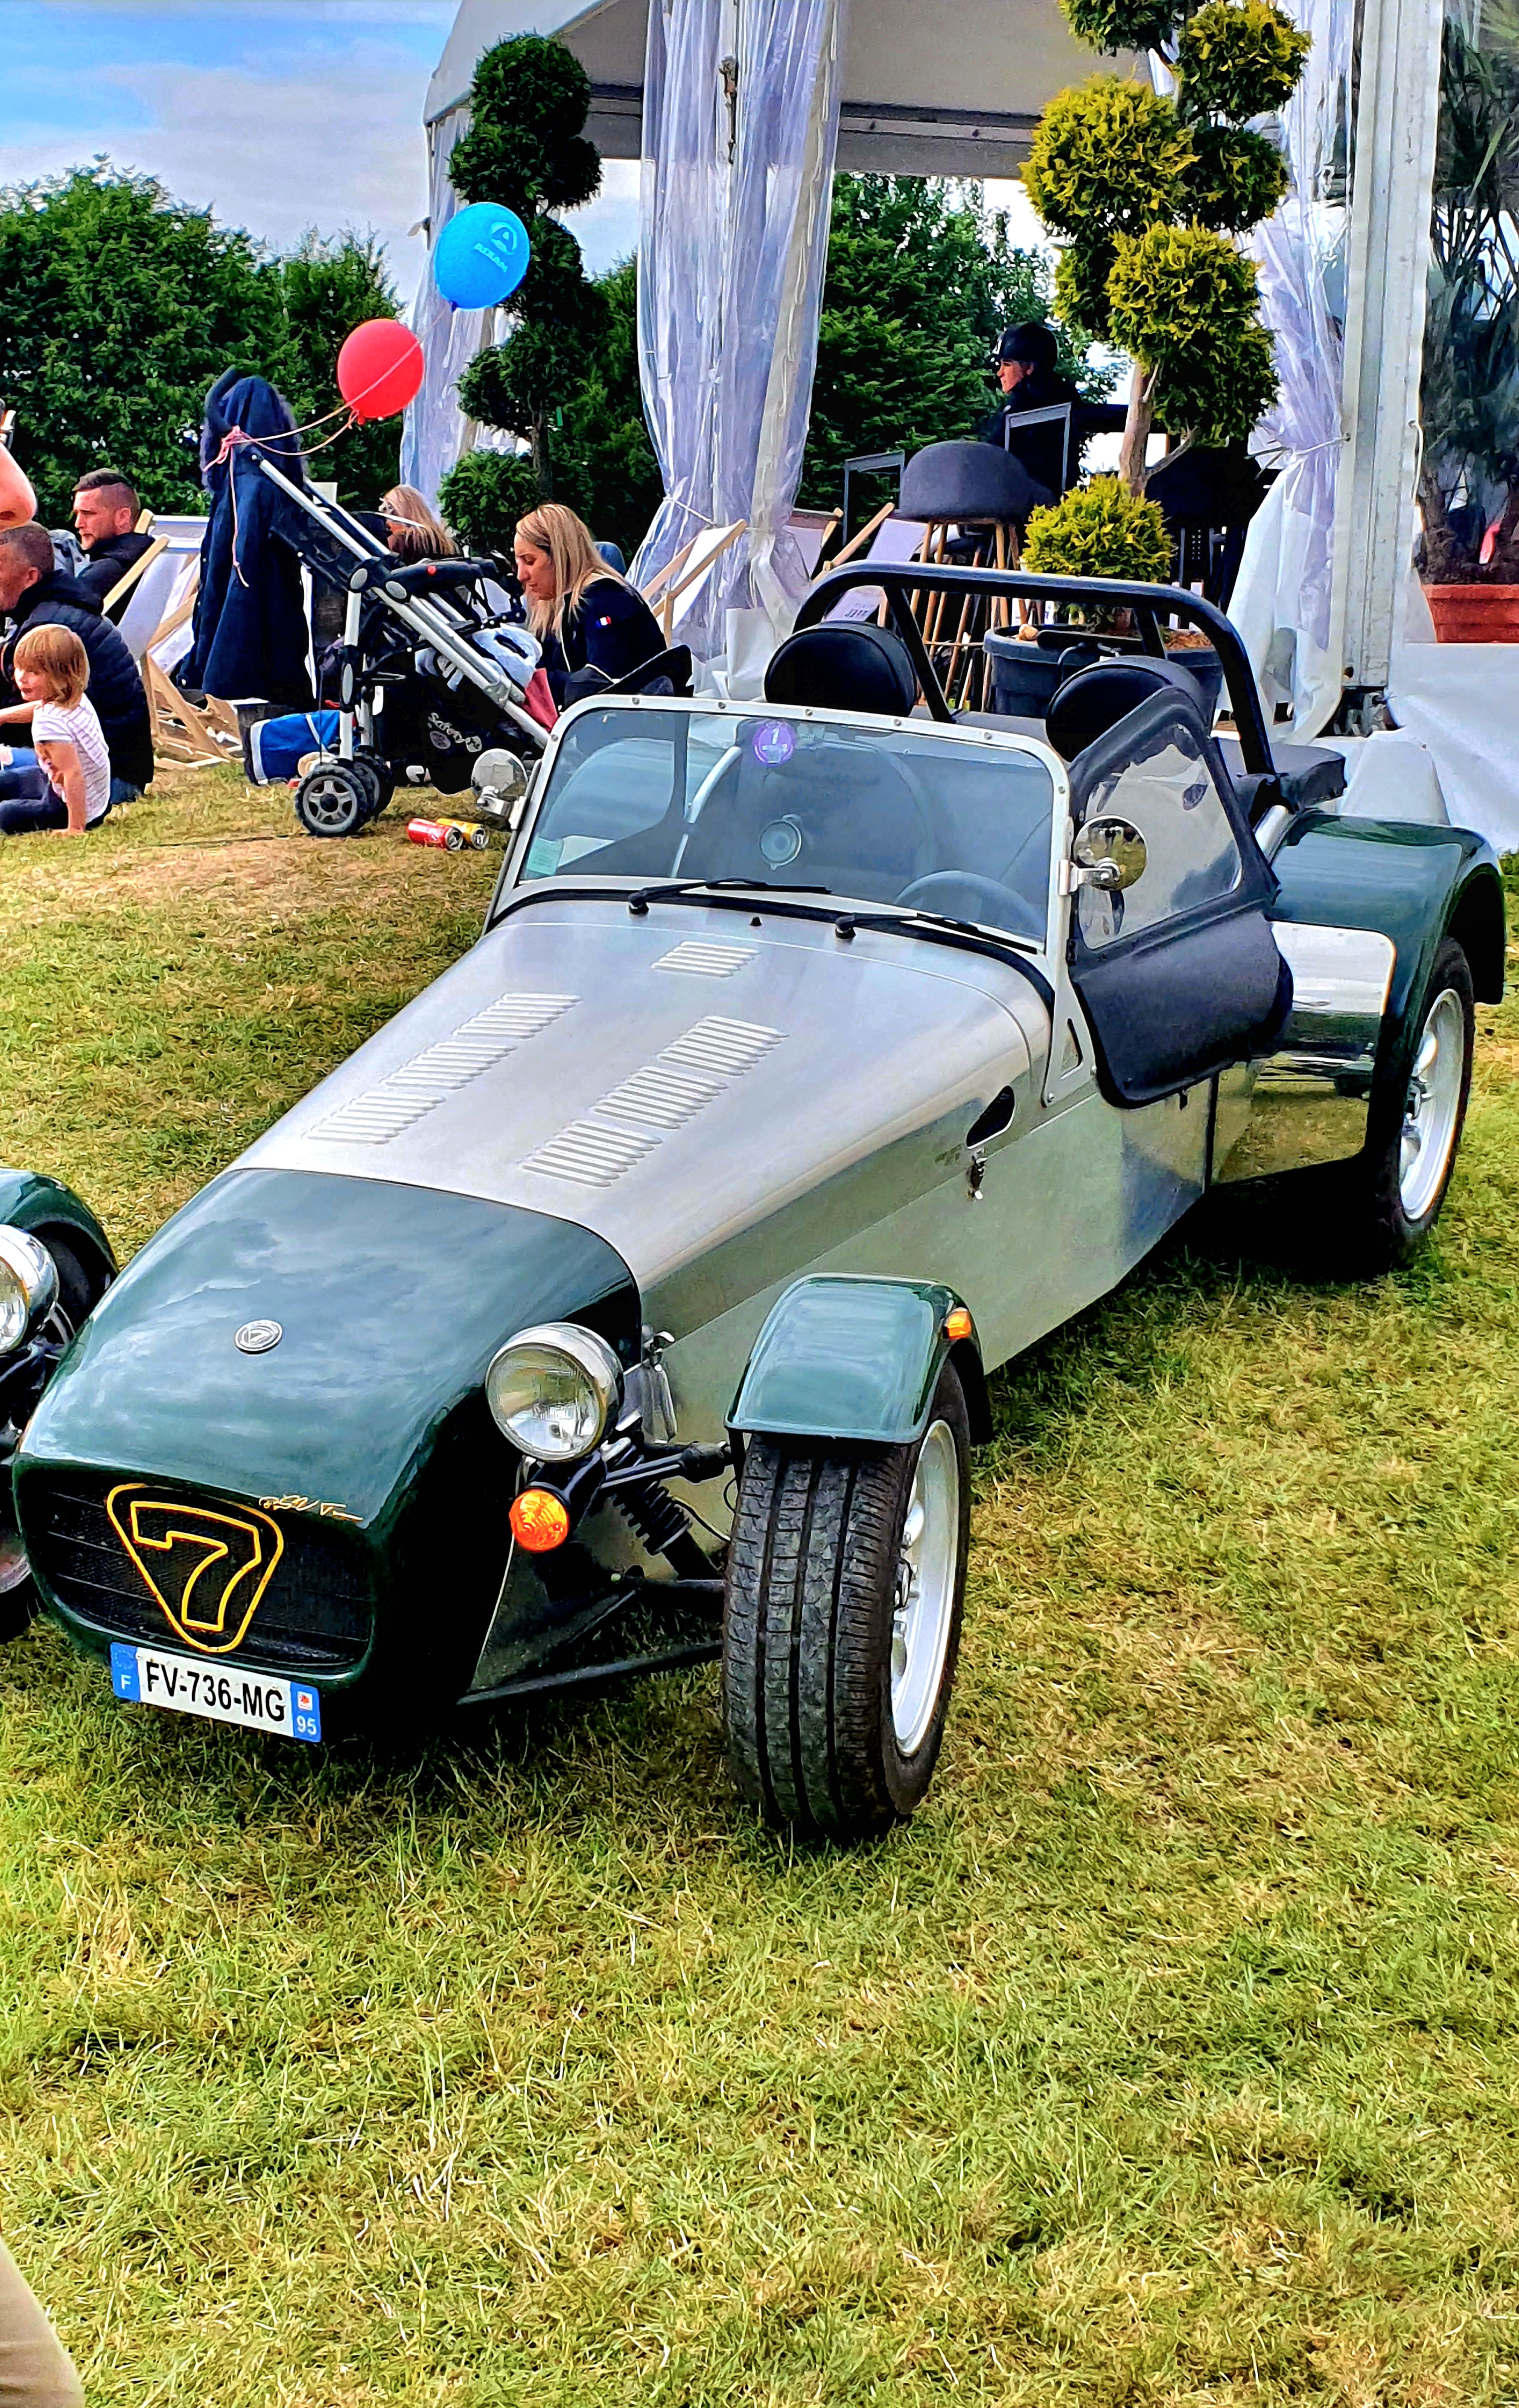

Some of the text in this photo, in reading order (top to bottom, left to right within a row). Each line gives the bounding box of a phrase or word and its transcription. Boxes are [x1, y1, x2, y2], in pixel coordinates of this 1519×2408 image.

[130, 1501, 262, 1632] 7
[121, 1675, 132, 1690] F
[146, 1661, 286, 1722] FV-736-MG
[296, 1714, 317, 1736] 95
